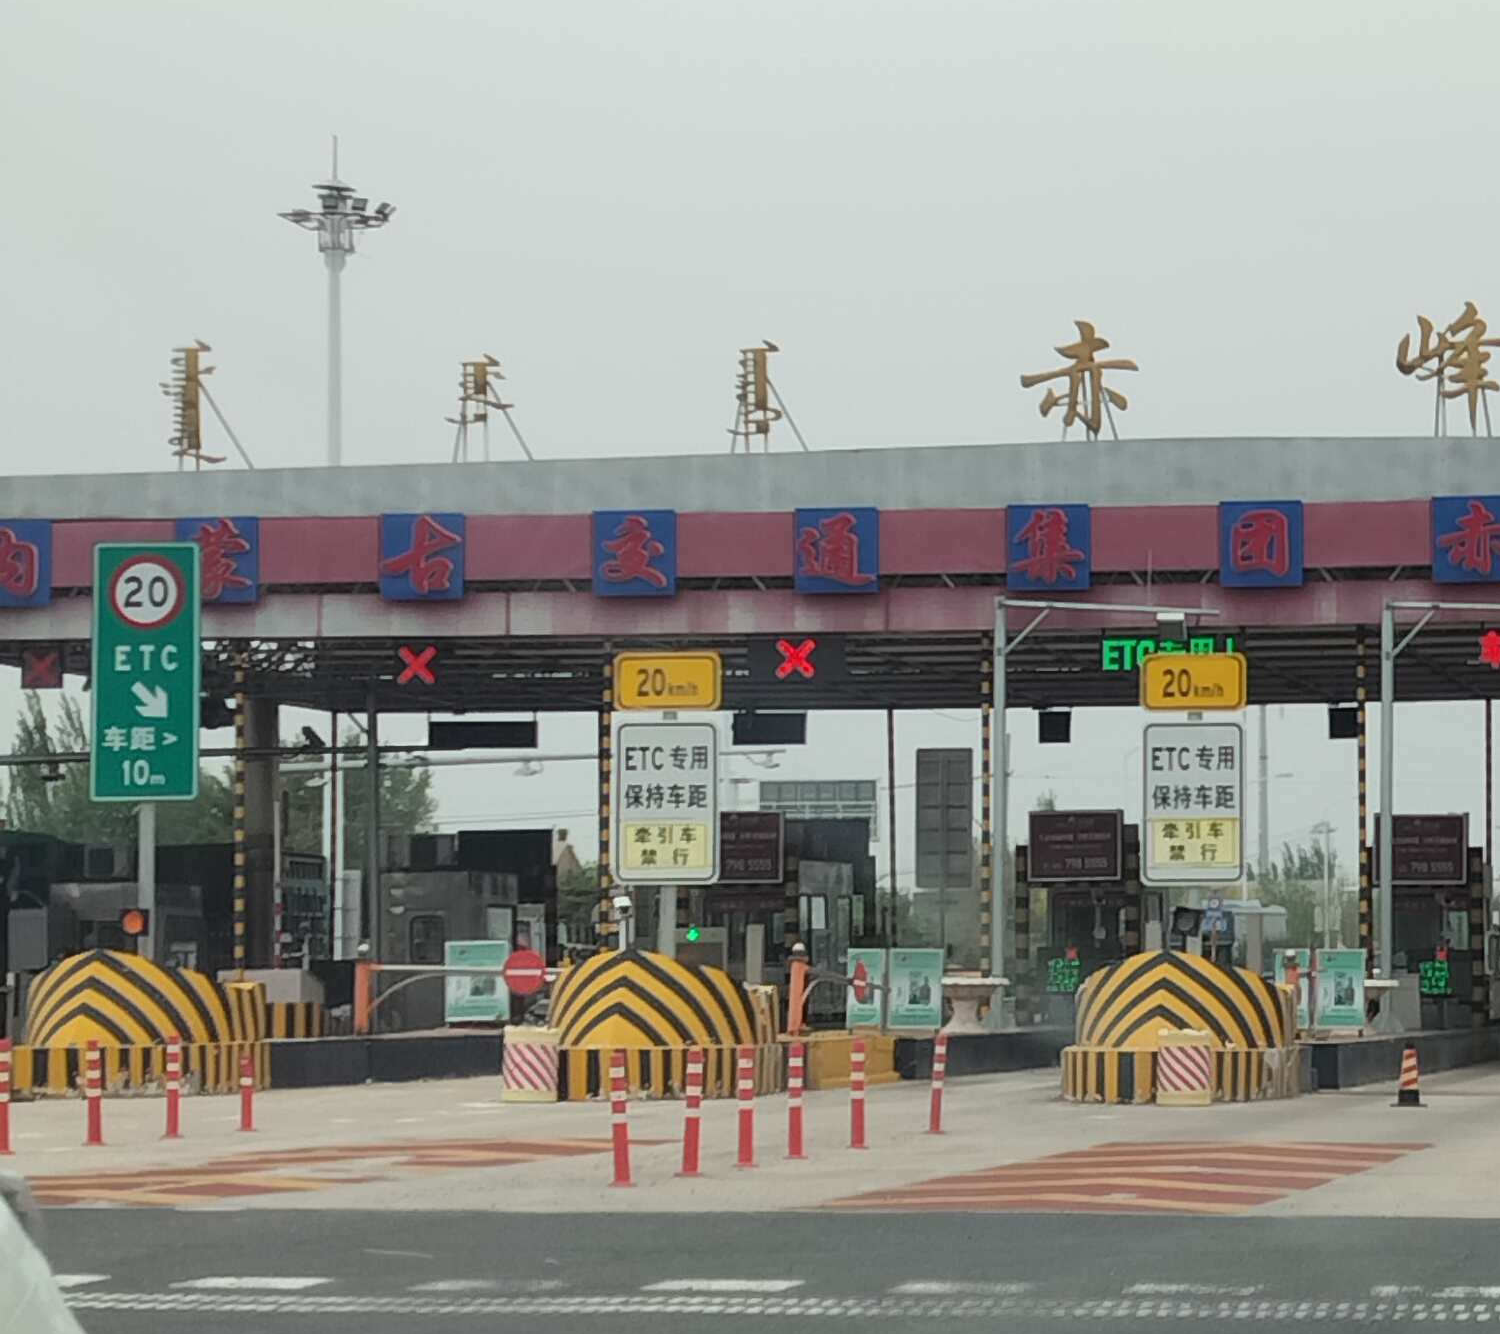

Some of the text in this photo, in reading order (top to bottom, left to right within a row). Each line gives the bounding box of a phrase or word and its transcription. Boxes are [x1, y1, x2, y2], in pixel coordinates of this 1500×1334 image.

[124, 575, 169, 608] 20
[113, 644, 179, 672] ETC
[625, 745, 709, 771] ETC 专用
[1151, 744, 1235, 771] ETC 专用
[122, 759, 166, 786] 10m
[625, 784, 708, 810] 保持车距
[1151, 784, 1236, 810] 保持车距
